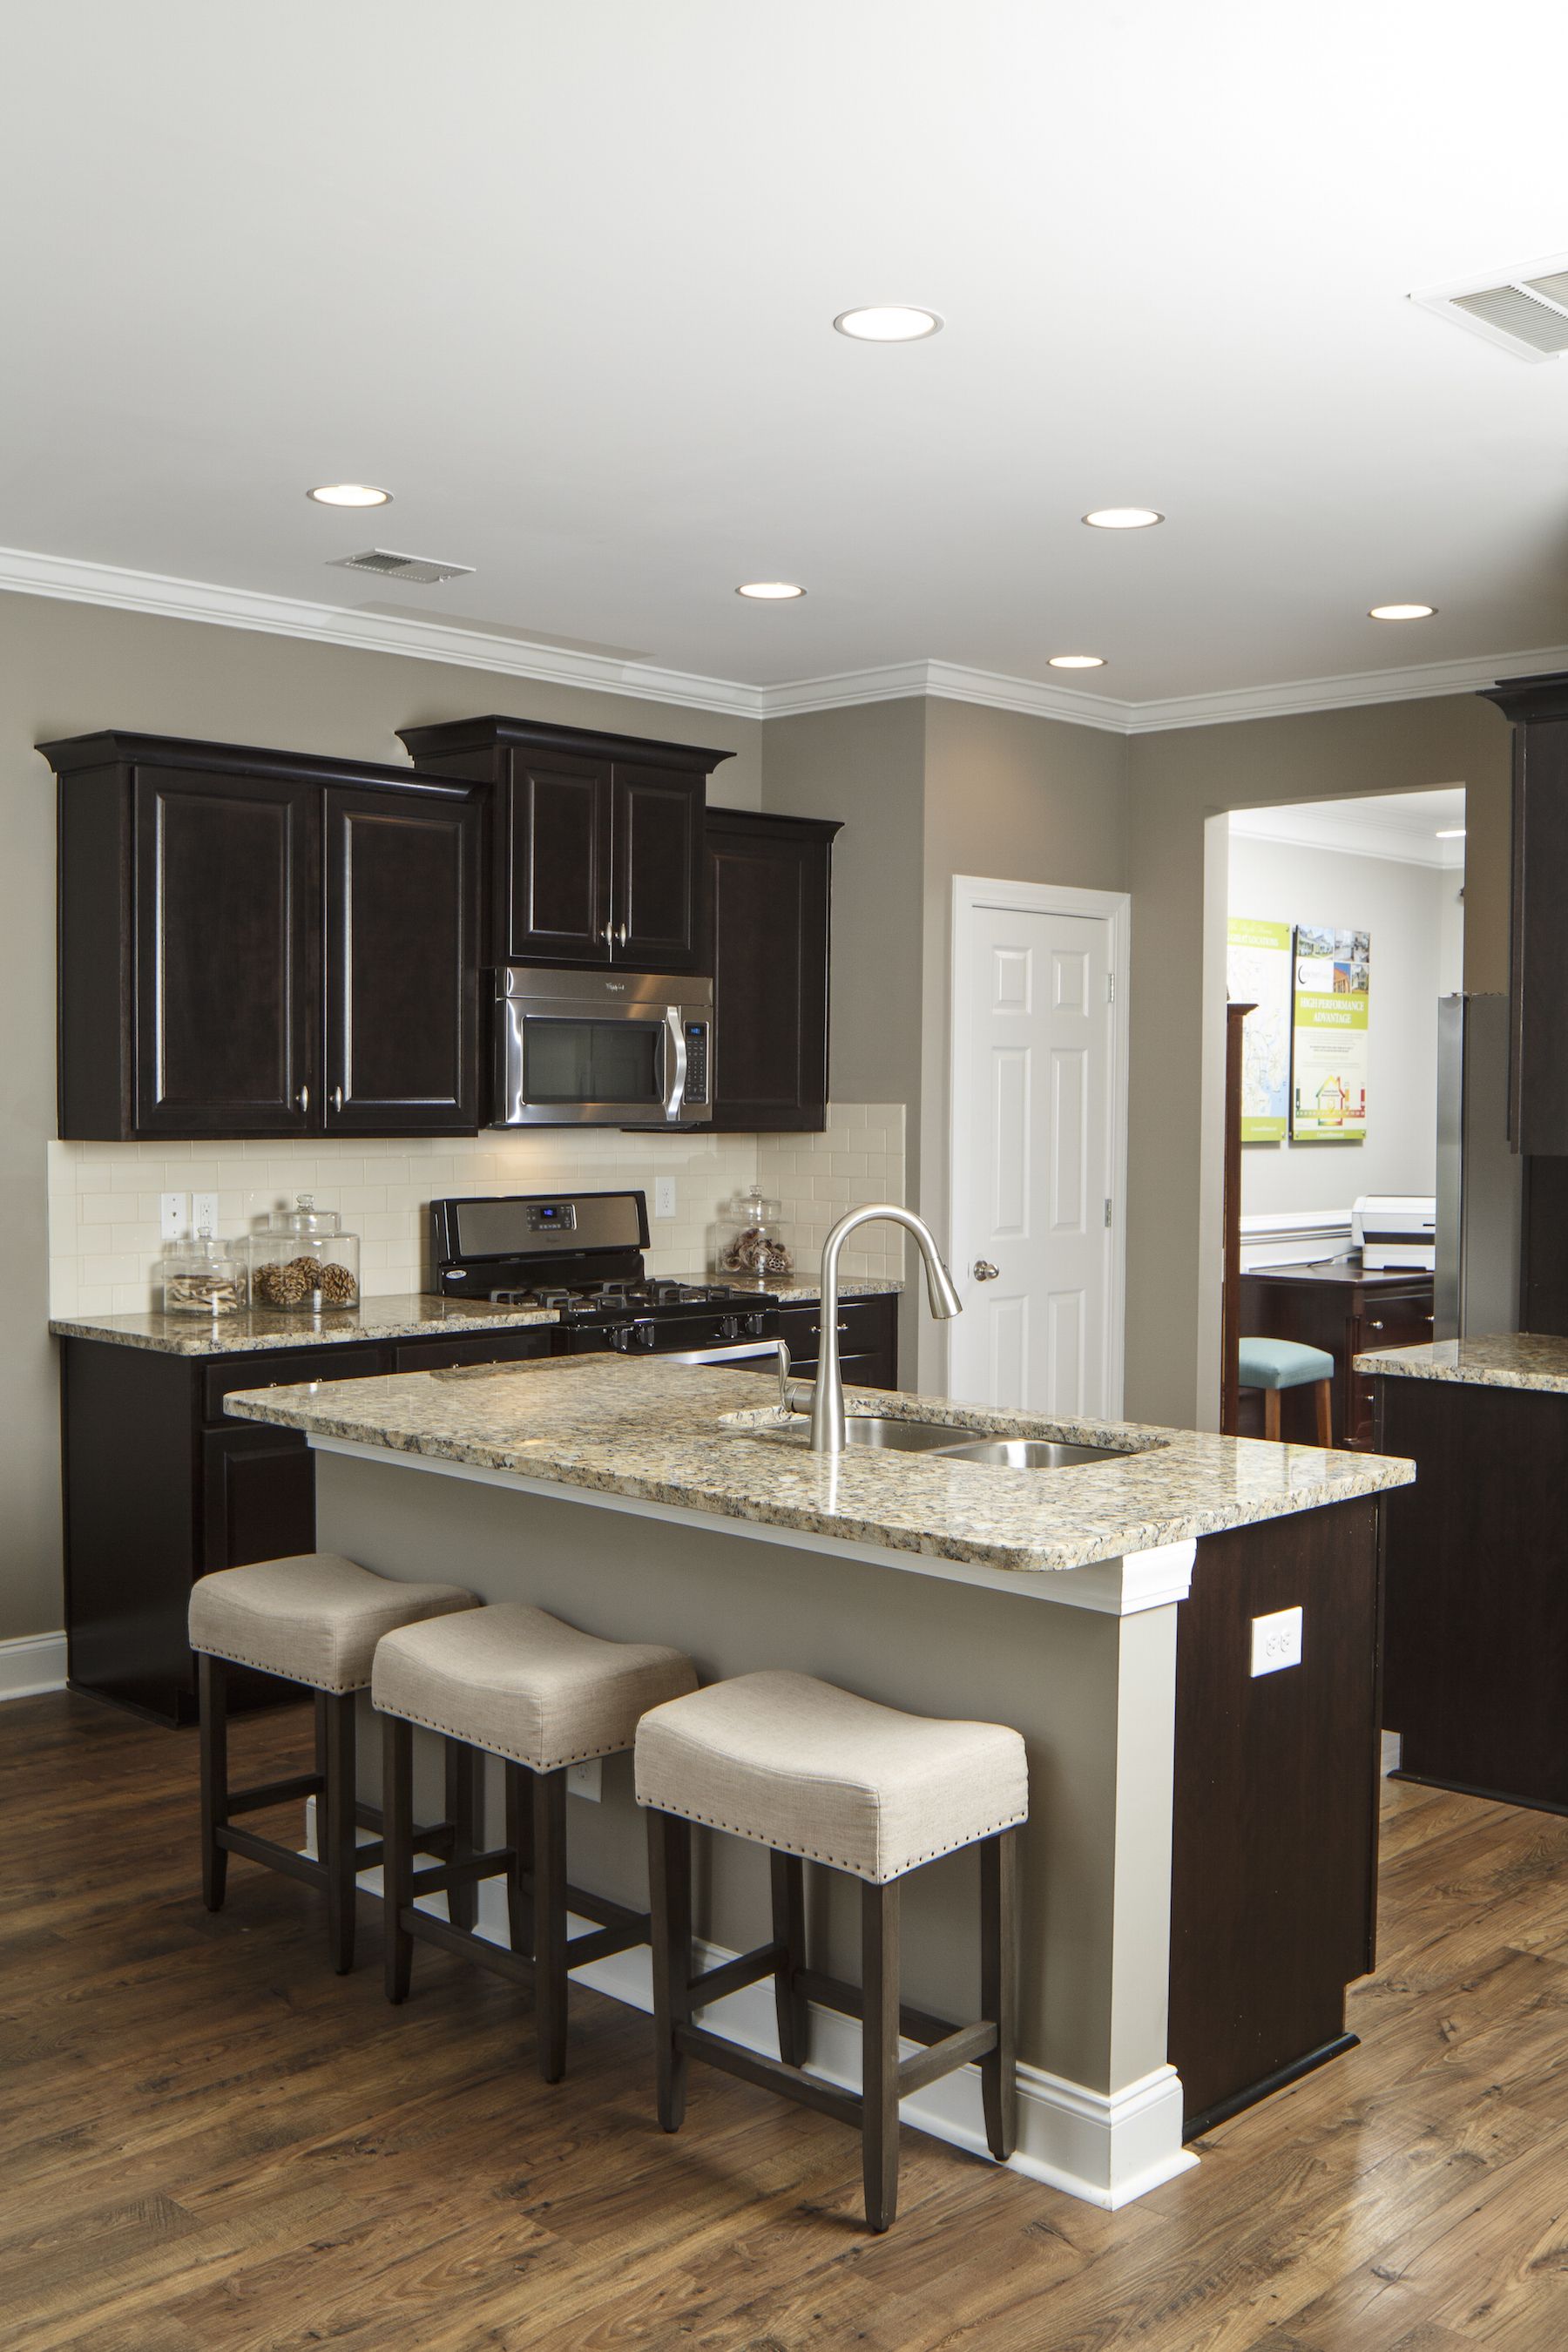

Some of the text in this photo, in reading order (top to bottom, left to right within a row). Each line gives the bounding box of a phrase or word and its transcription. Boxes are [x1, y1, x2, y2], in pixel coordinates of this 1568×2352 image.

[1301, 997, 1364, 1010] HIGH PERFORMANCE
[1314, 1012, 1352, 1023] ADVANTAGE
